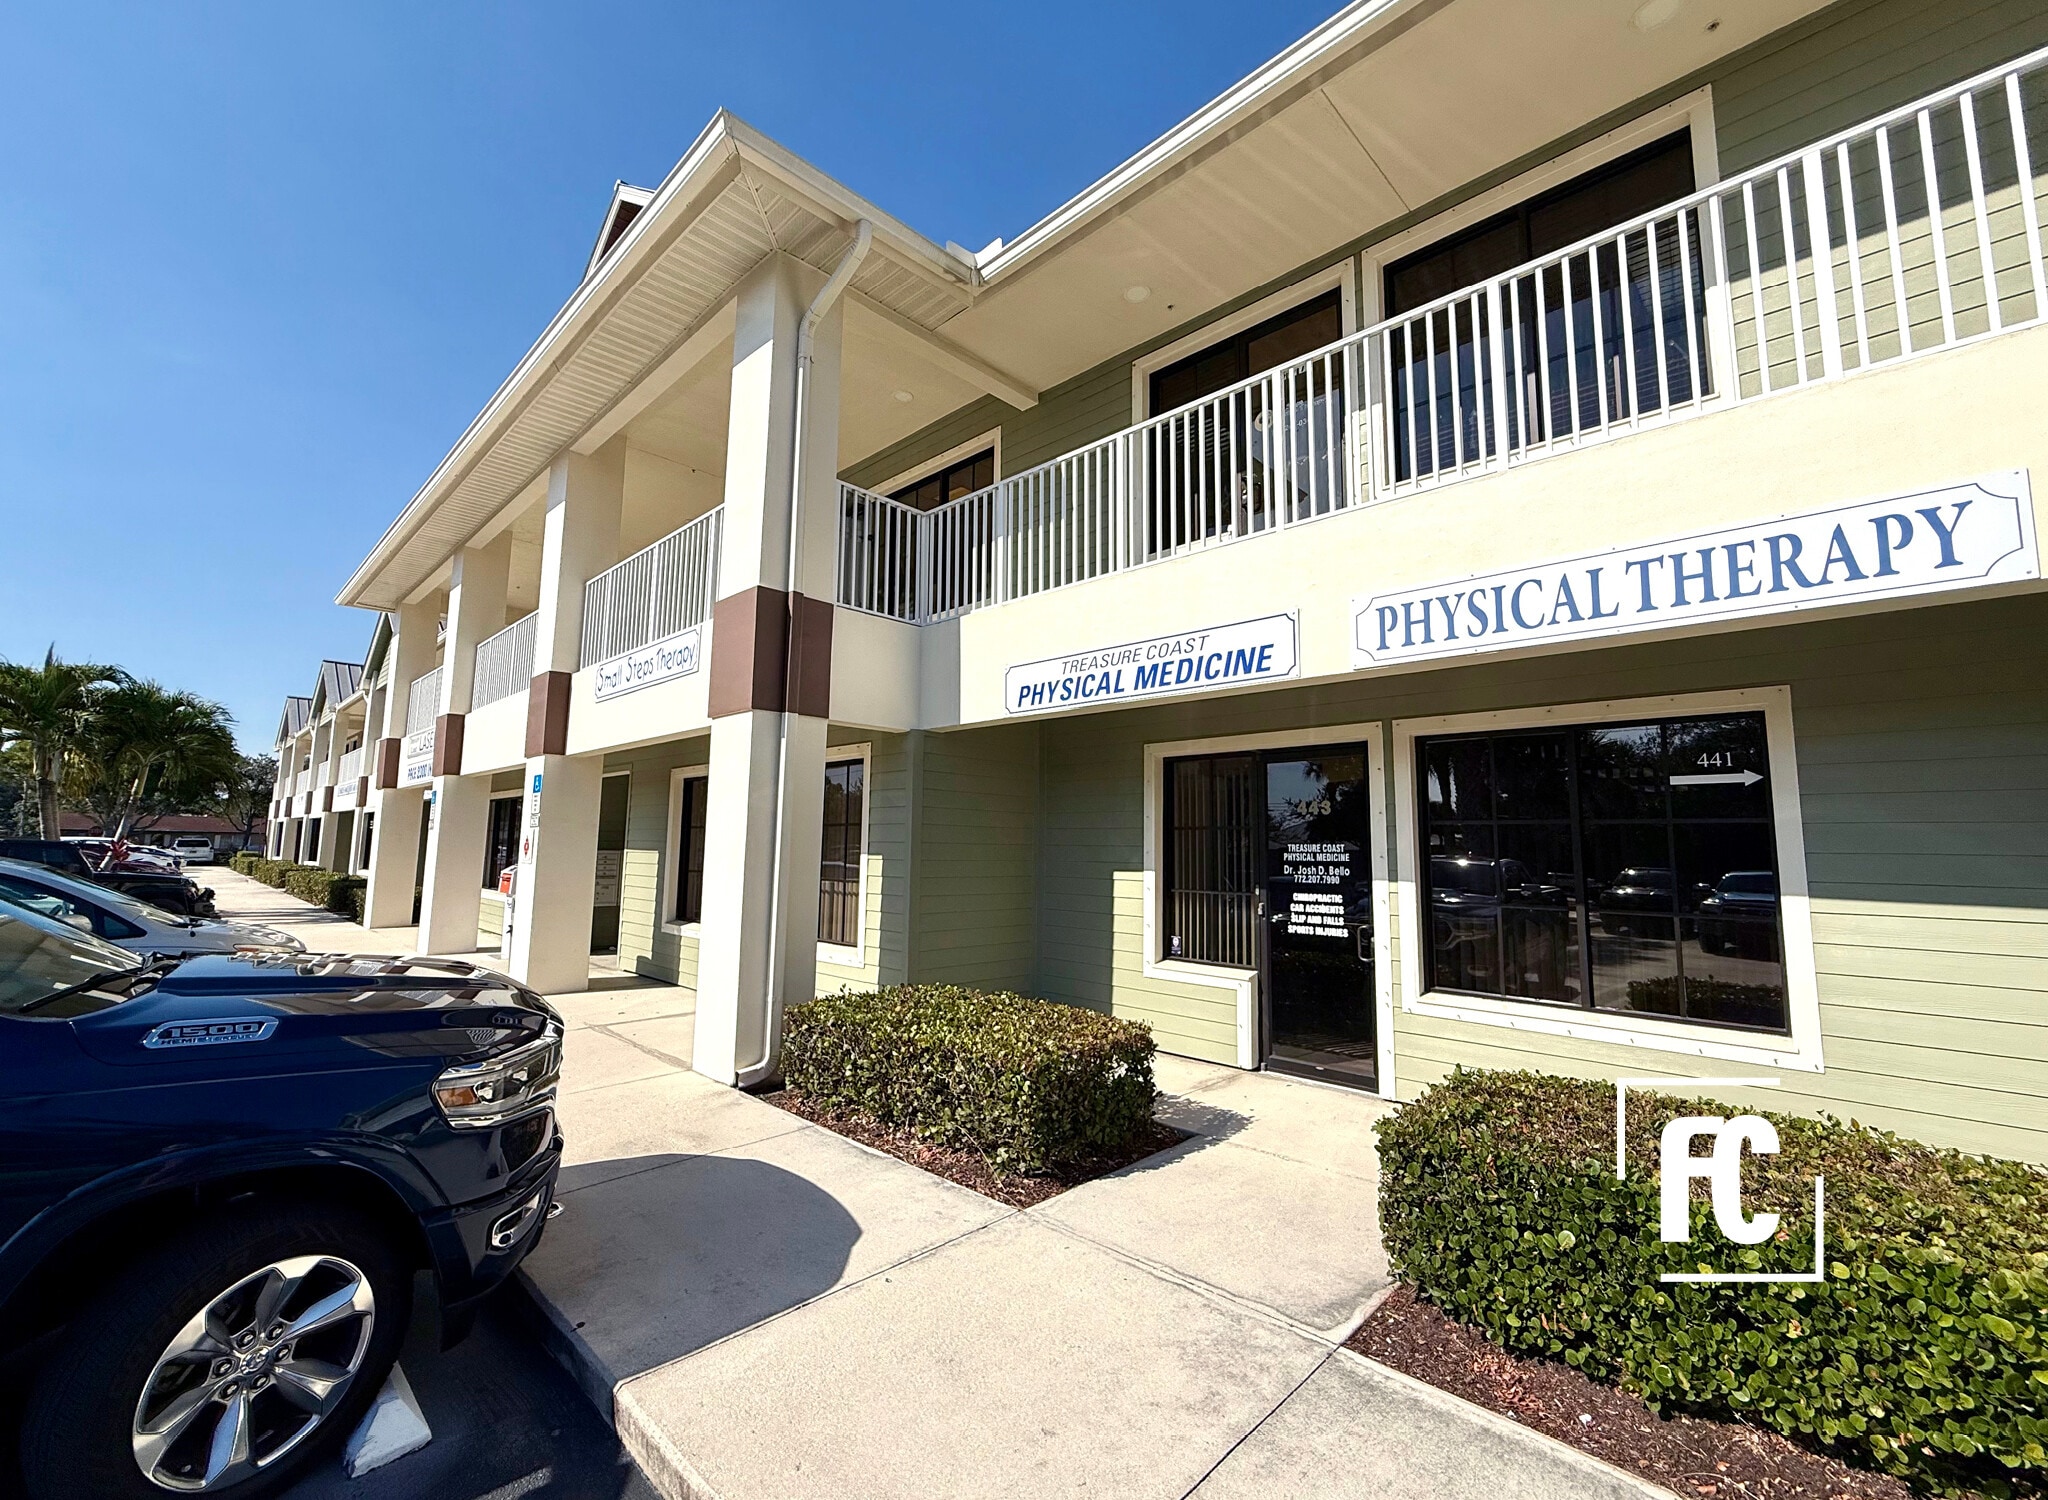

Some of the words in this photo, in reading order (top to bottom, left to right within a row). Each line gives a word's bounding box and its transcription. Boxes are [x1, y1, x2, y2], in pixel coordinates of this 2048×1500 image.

[1376, 567, 1619, 651] PHYSICAL
[1625, 500, 1973, 613] THERAPY
[1062, 647, 1142, 675] TREASURE
[1146, 635, 1209, 660] COAST
[598, 664, 623, 692] Small
[626, 656, 653, 682] Steps
[656, 643, 696, 671] Therapy
[1018, 669, 1125, 708] PHYSICAL
[1133, 643, 1274, 691] MEDICINE
[1697, 751, 1733, 768] 441
[1297, 800, 1331, 815] 443
[1287, 843, 1321, 852] TREASURE
[1322, 843, 1345, 853] COAST
[1283, 853, 1315, 861] PHYSICAL
[1316, 853, 1350, 862] MEDICINE
[1284, 865, 1296, 874] Dr.
[1297, 865, 1316, 875] Josh
[1318, 865, 1327, 876] D.
[1329, 866, 1350, 876] Bello
[1294, 875, 1340, 884] 772.207.7990
[1293, 892, 1343, 903] CHIROPRACTIC
[1290, 903, 1304, 912] CAR
[1305, 904, 1344, 914] ACCIDENTS
[1291, 914, 1306, 923] SLIP
[1307, 915, 1322, 924] AND
[1323, 916, 1344, 926] FALLS
[1288, 925, 1314, 935] SPORTS
[1315, 926, 1348, 937] INJURIES
[169, 1023, 259, 1037] 1500
